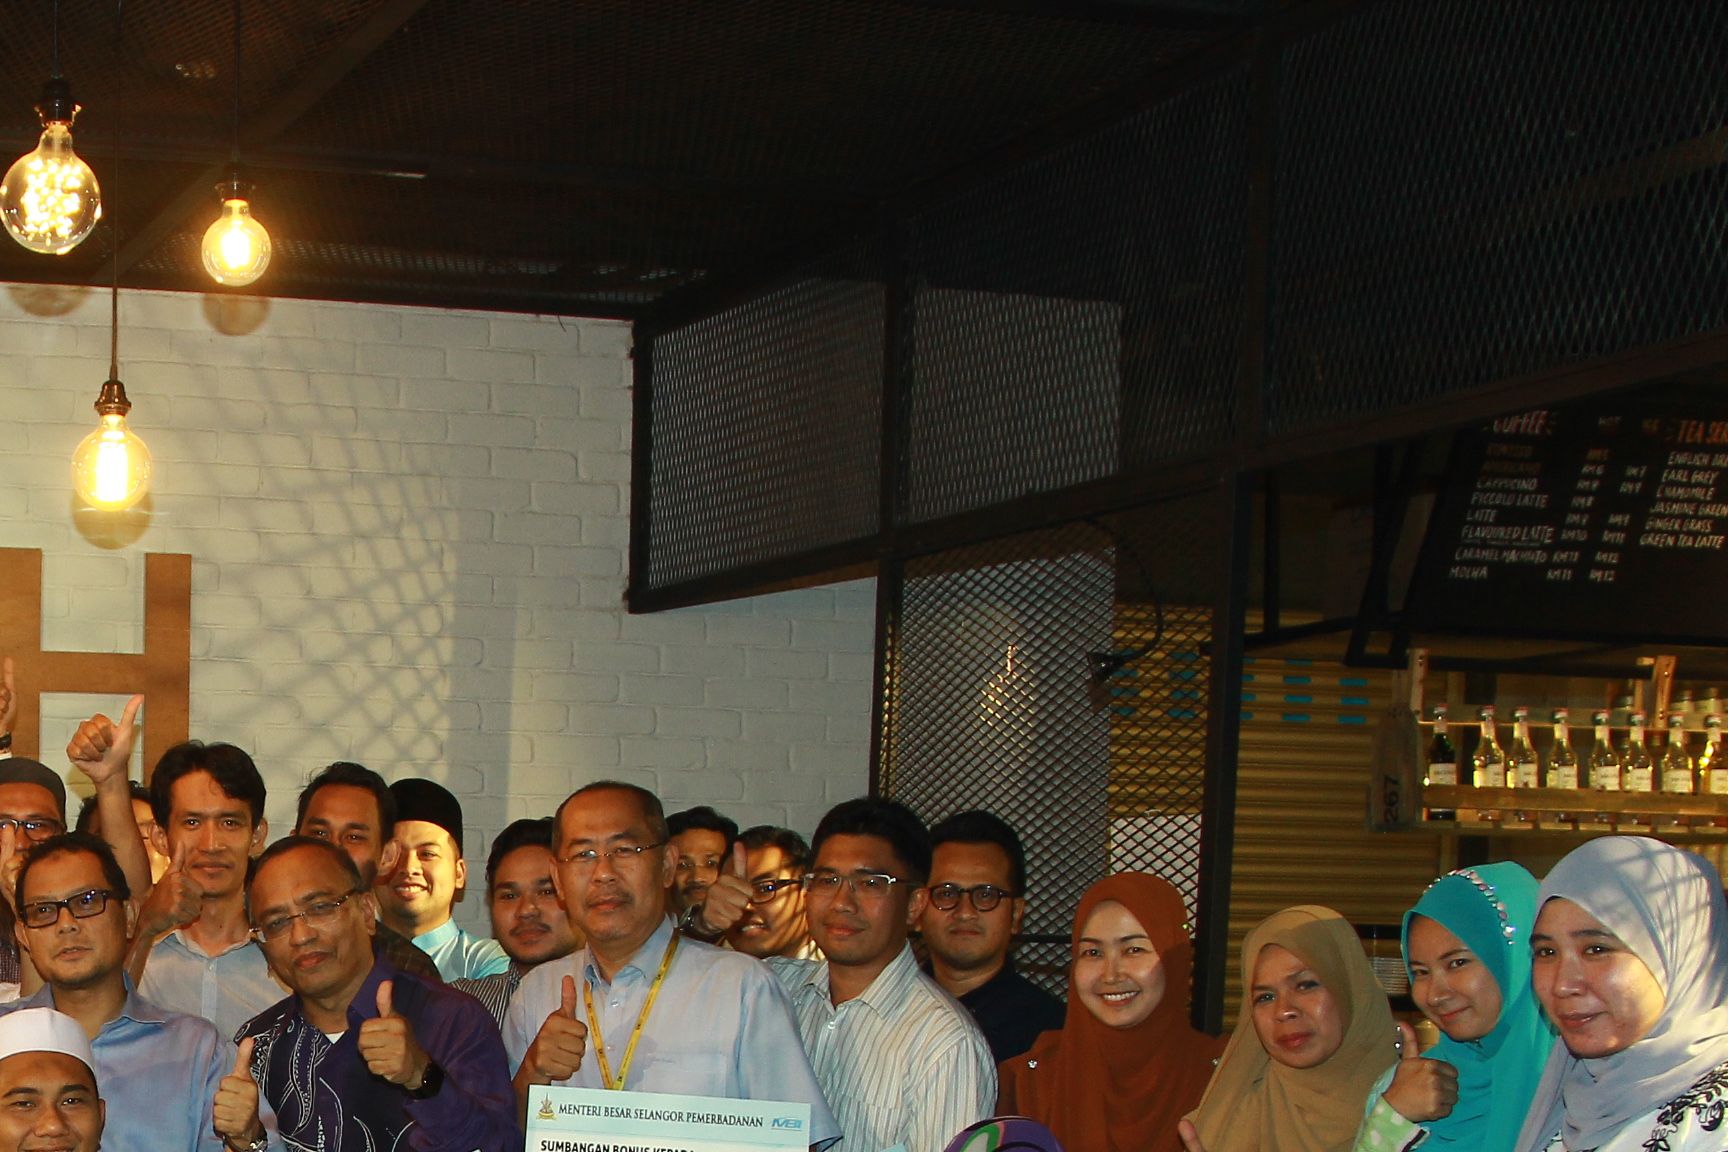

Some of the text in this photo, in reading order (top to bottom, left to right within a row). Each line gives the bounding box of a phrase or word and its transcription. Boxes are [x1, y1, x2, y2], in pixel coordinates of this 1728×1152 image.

[1677, 421, 1703, 443] TEA
[1662, 469, 1719, 483] EARL GREY
[1515, 494, 1549, 508] LATTE
[1466, 508, 1498, 523] LATTE
[1645, 517, 1681, 531] GINGER
[1521, 526, 1555, 543] LATTE
[1640, 533, 1674, 546] GREEN
[1694, 535, 1725, 549] LATTE
[558, 1103, 763, 1127] MENTERI BESAR SELANGOR PEMERBADANAN
